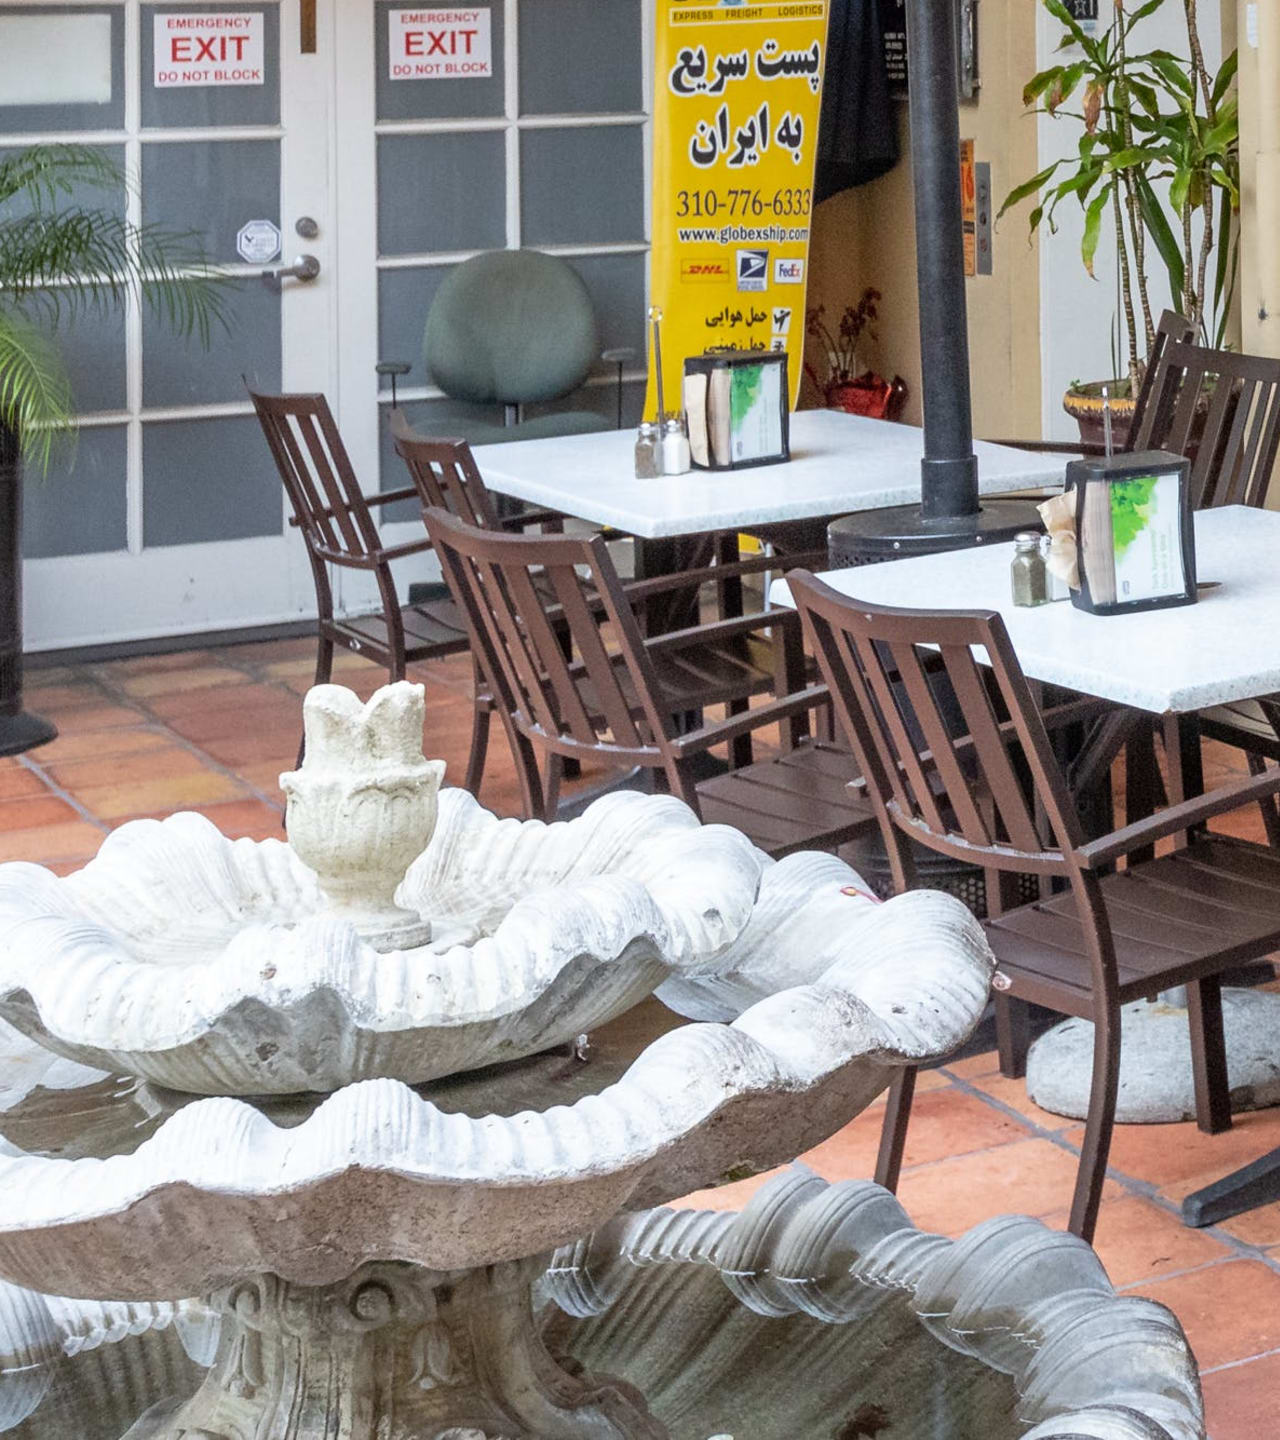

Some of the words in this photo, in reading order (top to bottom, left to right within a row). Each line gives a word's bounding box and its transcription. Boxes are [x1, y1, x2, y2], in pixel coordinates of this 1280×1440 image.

[166, 16, 252, 31] EMERGENCY
[400, 11, 480, 26] EMERGENCY
[673, 10, 714, 22] EXPRESS
[725, 7, 763, 19] FREIGHT
[778, 4, 824, 17] LOGISTICS
[170, 35, 251, 63] EXIT
[404, 28, 479, 57] EXIT
[158, 71, 179, 83] DO
[182, 70, 211, 82] NOT
[214, 69, 261, 82] BLOCK
[392, 64, 413, 76] DO
[416, 63, 442, 75] NOT
[445, 62, 488, 74] BLOCK
[670, 46, 748, 94] سریع
[757, 39, 821, 92] پست
[690, 102, 769, 167] ایران
[776, 112, 804, 165] به
[676, 188, 811, 218] 310-776-6333
[679, 225, 809, 244] www.globexship.com
[778, 263, 801, 278] FedEx
[745, 306, 768, 328] حمل
